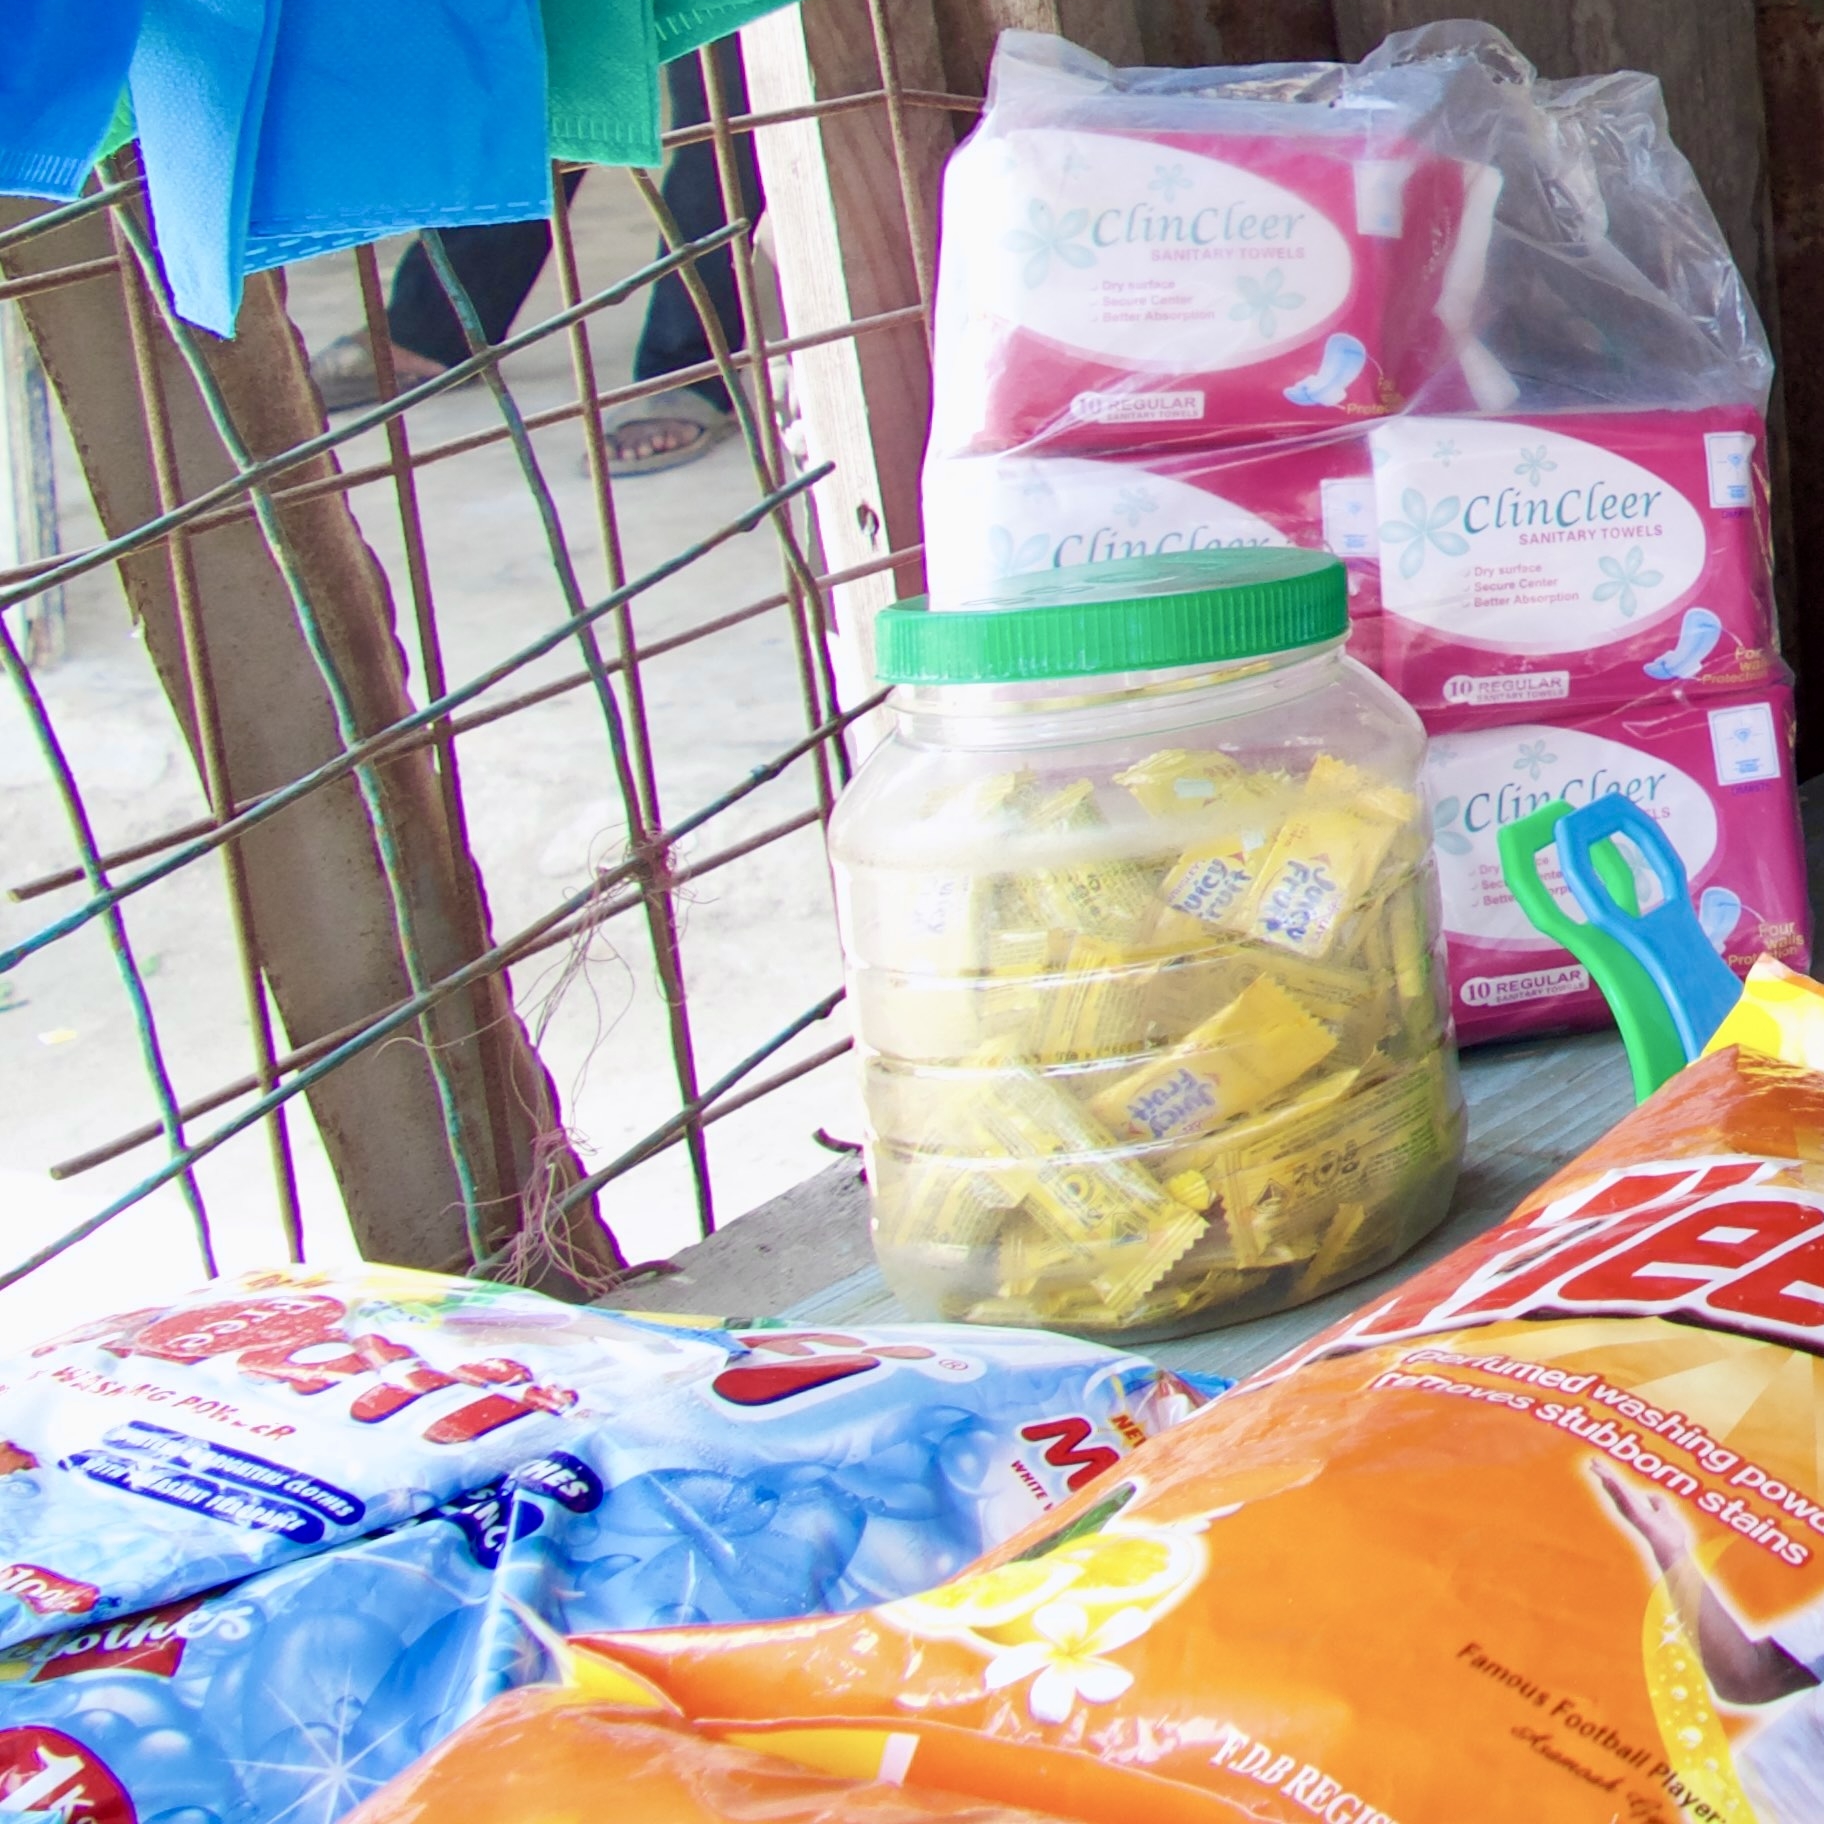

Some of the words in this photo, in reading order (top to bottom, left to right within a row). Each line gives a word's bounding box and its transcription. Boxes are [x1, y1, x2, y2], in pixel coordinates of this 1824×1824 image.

[1092, 201, 1307, 248] ClinCleer
[1150, 247, 1235, 262] SANITARY
[1238, 246, 1306, 260] TOWELS
[1462, 481, 1663, 536] ClinCleer
[1518, 527, 1598, 546] SANITARY
[1601, 524, 1664, 542] TOWELS
[1474, 565, 1495, 579] Dry
[1498, 562, 1543, 576] surface
[1474, 579, 1516, 592] Secure
[1518, 577, 1558, 590] Center
[1474, 595, 1511, 609] Better
[1513, 592, 1580, 608] Absorption
[1449, 679, 1474, 697] 10
[1477, 676, 1563, 693] REGULAR
[1466, 981, 1491, 1000] 10
[1495, 968, 1582, 994] REGULAR
[1407, 1349, 1597, 1395] perfumed
[1594, 1384, 1738, 1474] washing
[1010, 1459, 1049, 1501] WHITE
[1375, 1371, 1536, 1411] removes
[1536, 1398, 1700, 1498] stubborn
[1698, 1489, 1811, 1566] stains
[1456, 1641, 1550, 1708] Famous
[1550, 1696, 1651, 1769] Football
